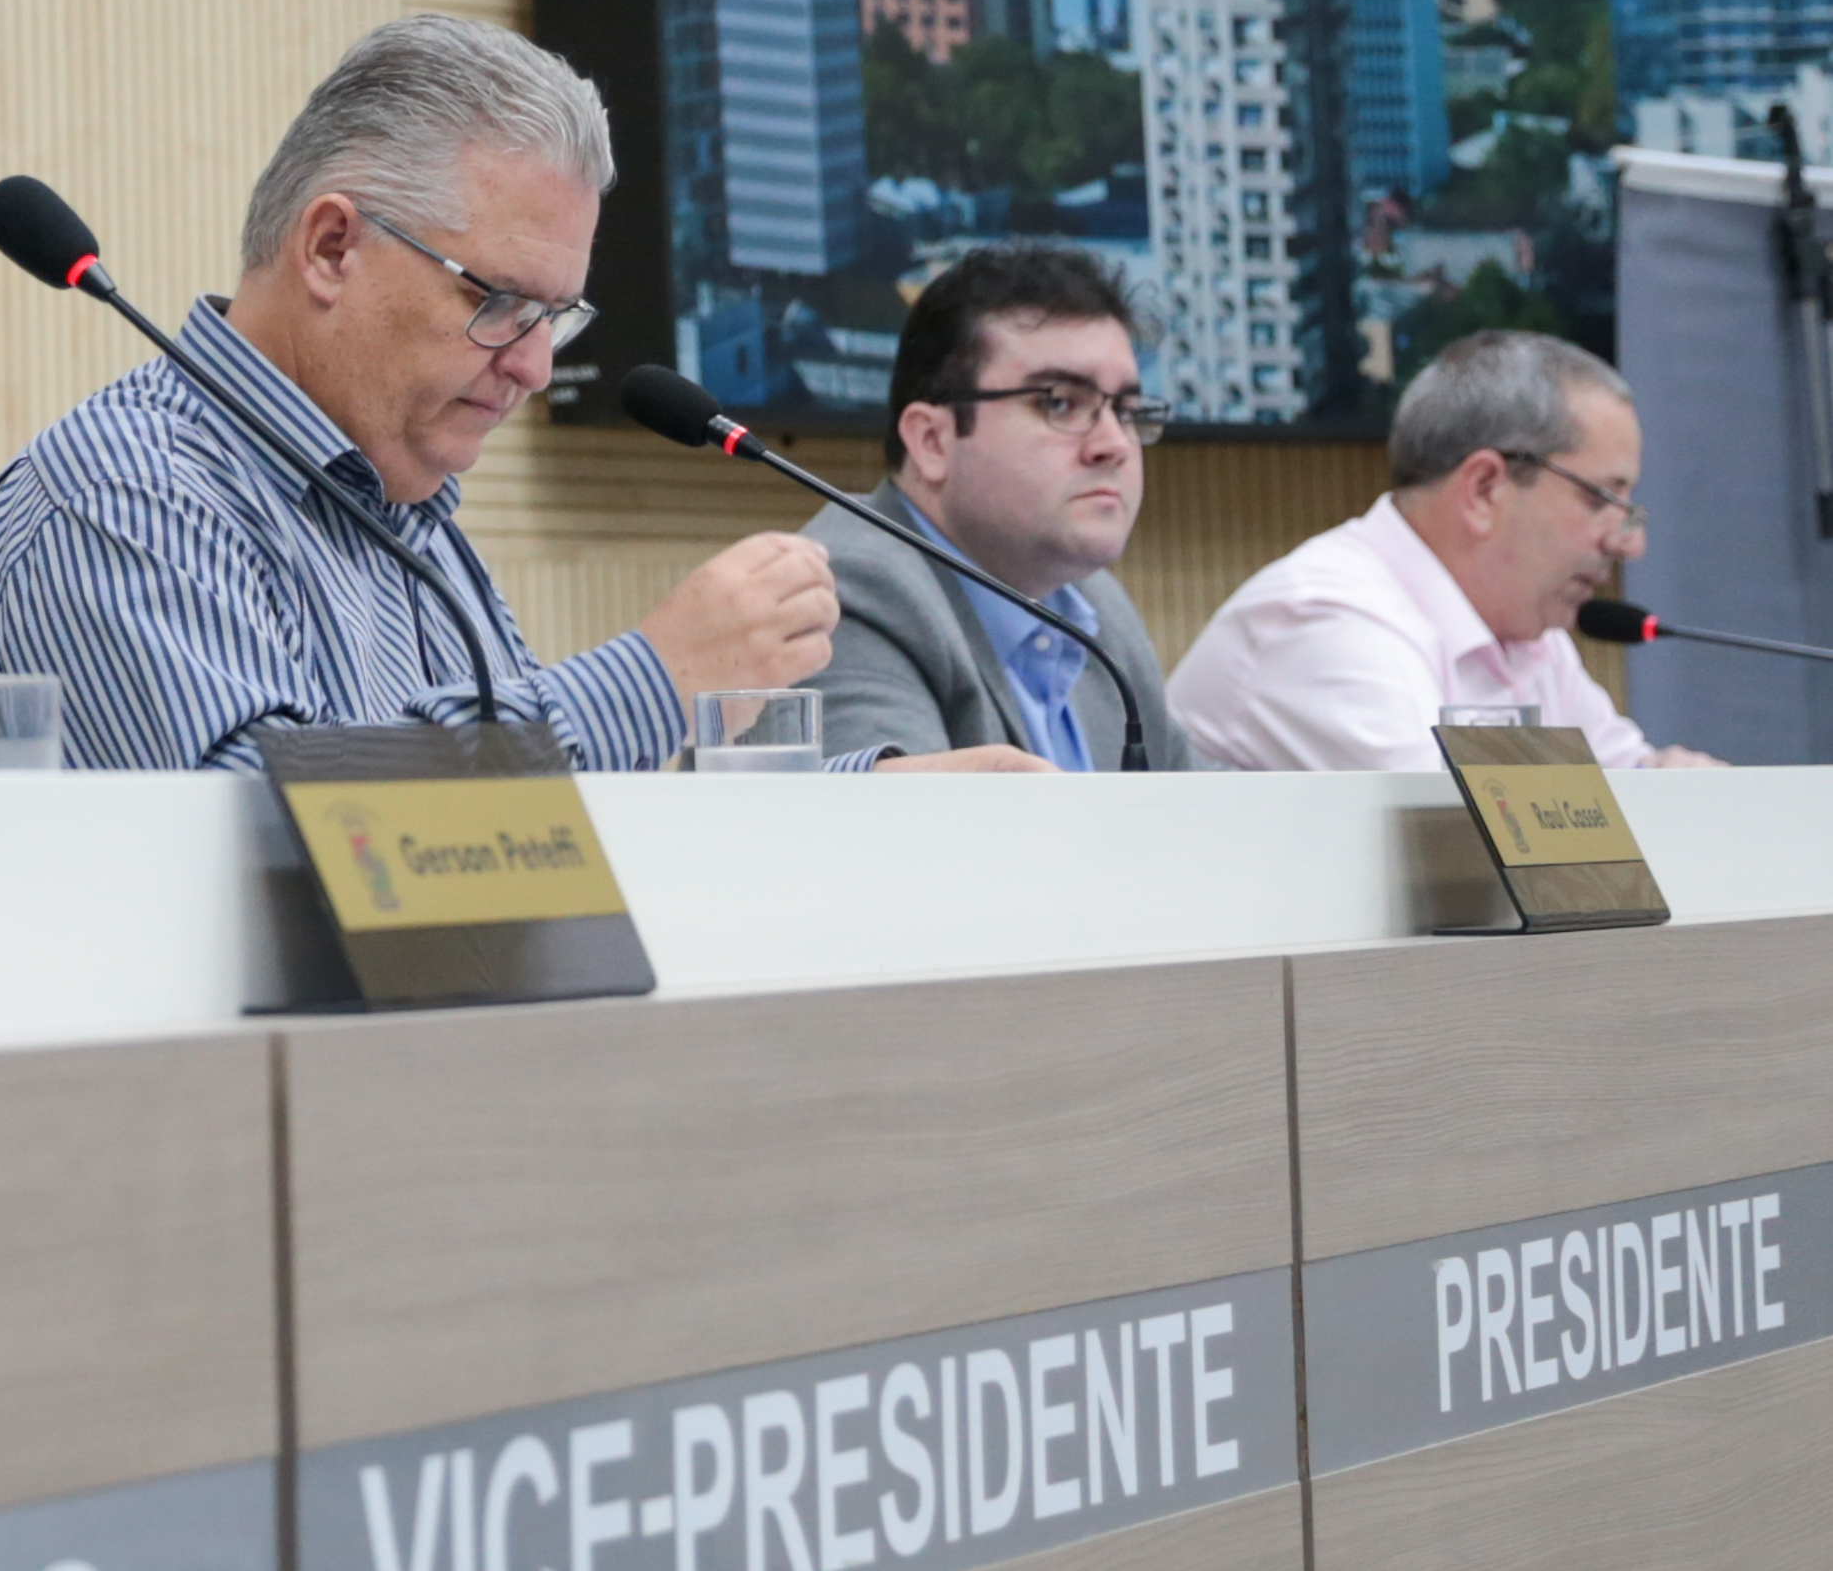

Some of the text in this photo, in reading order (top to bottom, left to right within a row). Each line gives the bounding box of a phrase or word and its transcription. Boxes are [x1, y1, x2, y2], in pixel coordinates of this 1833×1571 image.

[398, 835, 500, 877] Gerson
[1530, 798, 1610, 829] Raul Cassel
[1432, 1193, 1784, 1412] PRESIDENTE
[359, 1302, 1239, 1571] VICE-PRESIDENTE
